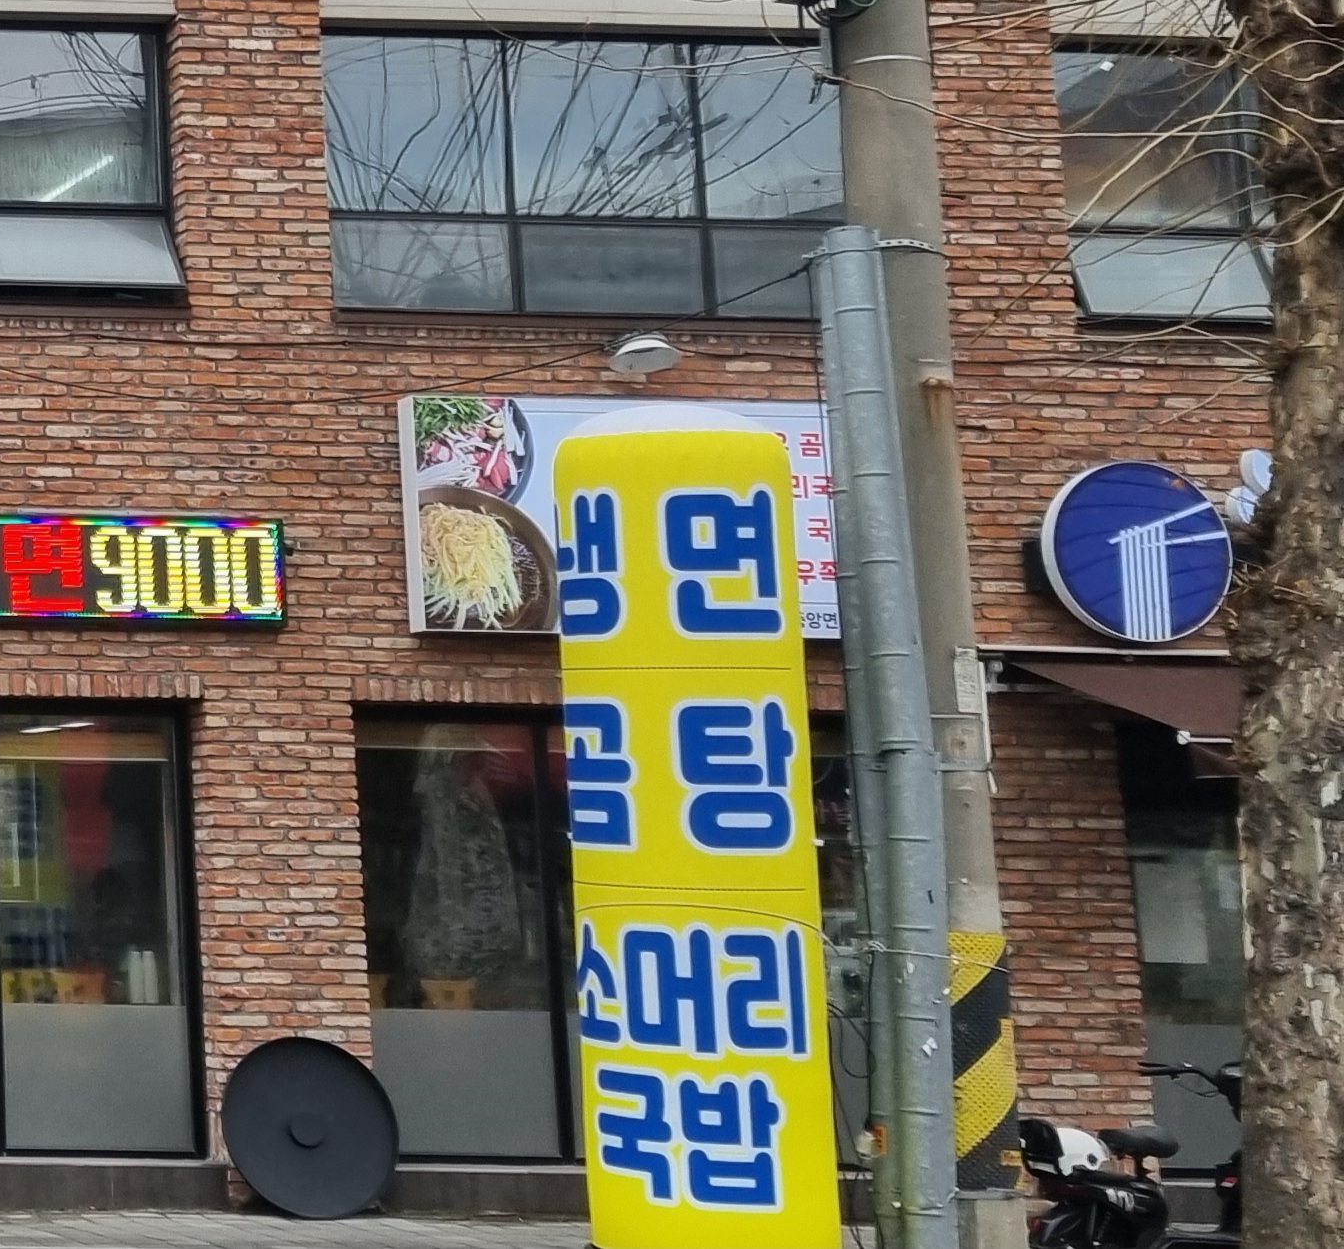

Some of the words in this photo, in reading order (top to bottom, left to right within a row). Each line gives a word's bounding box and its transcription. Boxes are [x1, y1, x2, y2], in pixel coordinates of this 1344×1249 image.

[90, 525, 277, 615] 9000
[556, 489, 782, 636] 냉면
[565, 699, 794, 851] 곰탕
[577, 923, 808, 1057] 소머리
[598, 1067, 782, 1207] 국밥
